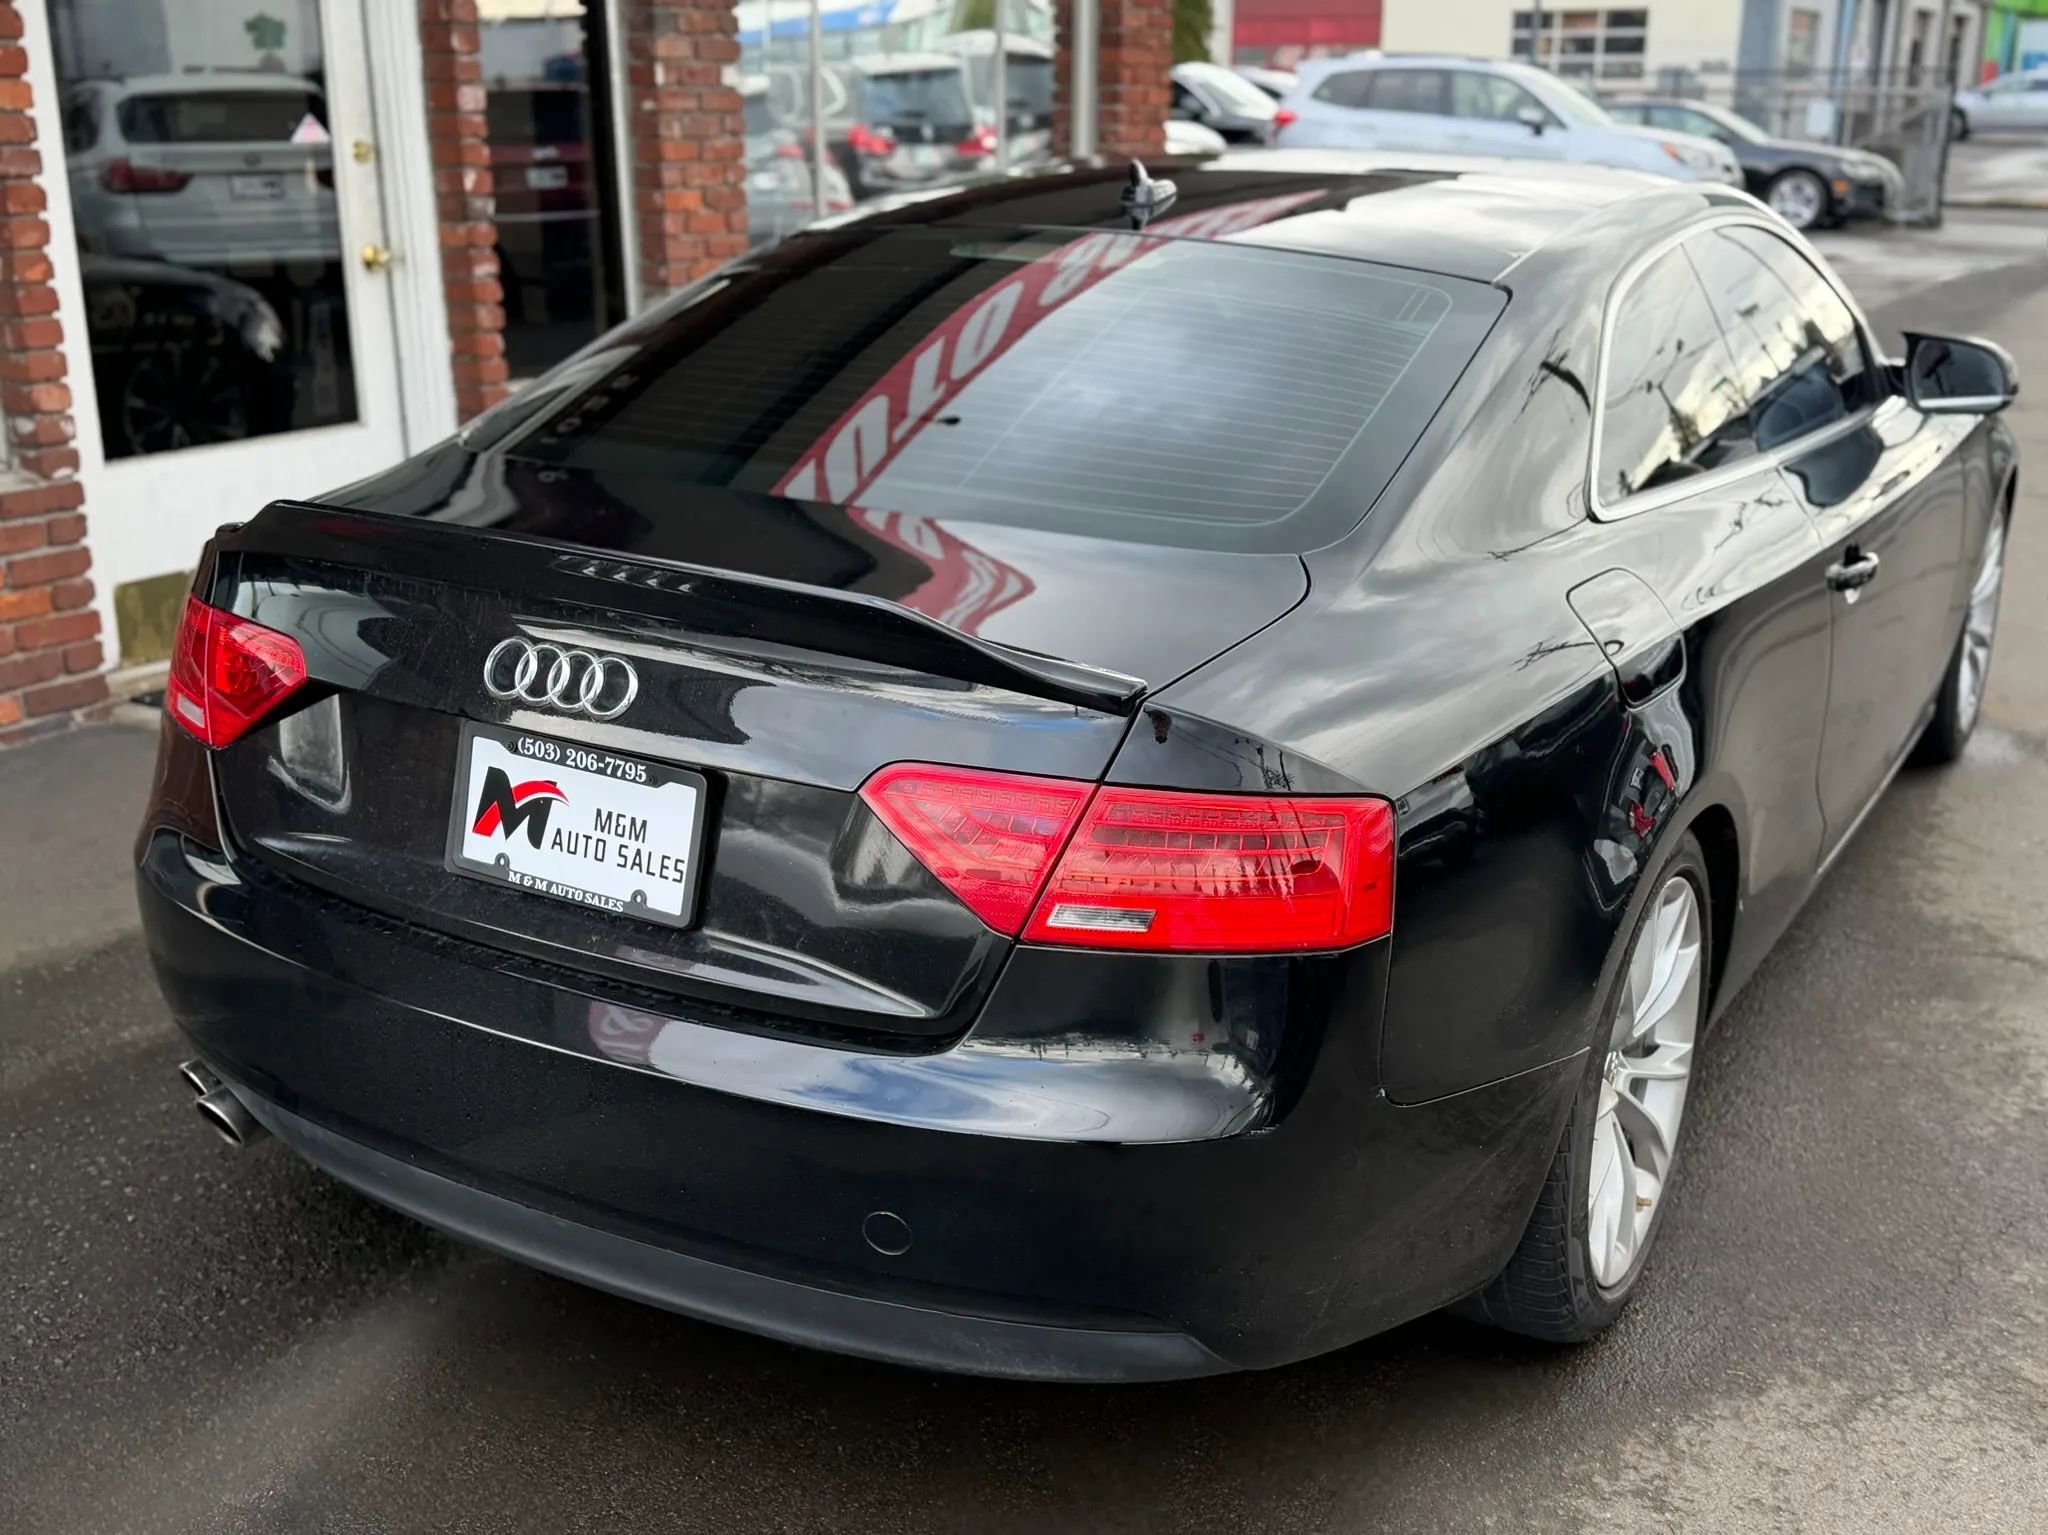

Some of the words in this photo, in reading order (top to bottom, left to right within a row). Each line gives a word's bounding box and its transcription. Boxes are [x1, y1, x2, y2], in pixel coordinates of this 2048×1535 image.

[517, 737, 561, 762] (503)
[566, 748, 648, 783] 206-7795
[594, 808, 648, 844] M&M
[551, 828, 607, 863] AUTO
[616, 844, 686, 884] SALES
[508, 871, 521, 884] M
[523, 874, 533, 887] &
[534, 877, 548, 891] M
[550, 881, 583, 902] AUTO
[584, 892, 625, 912] SALES
